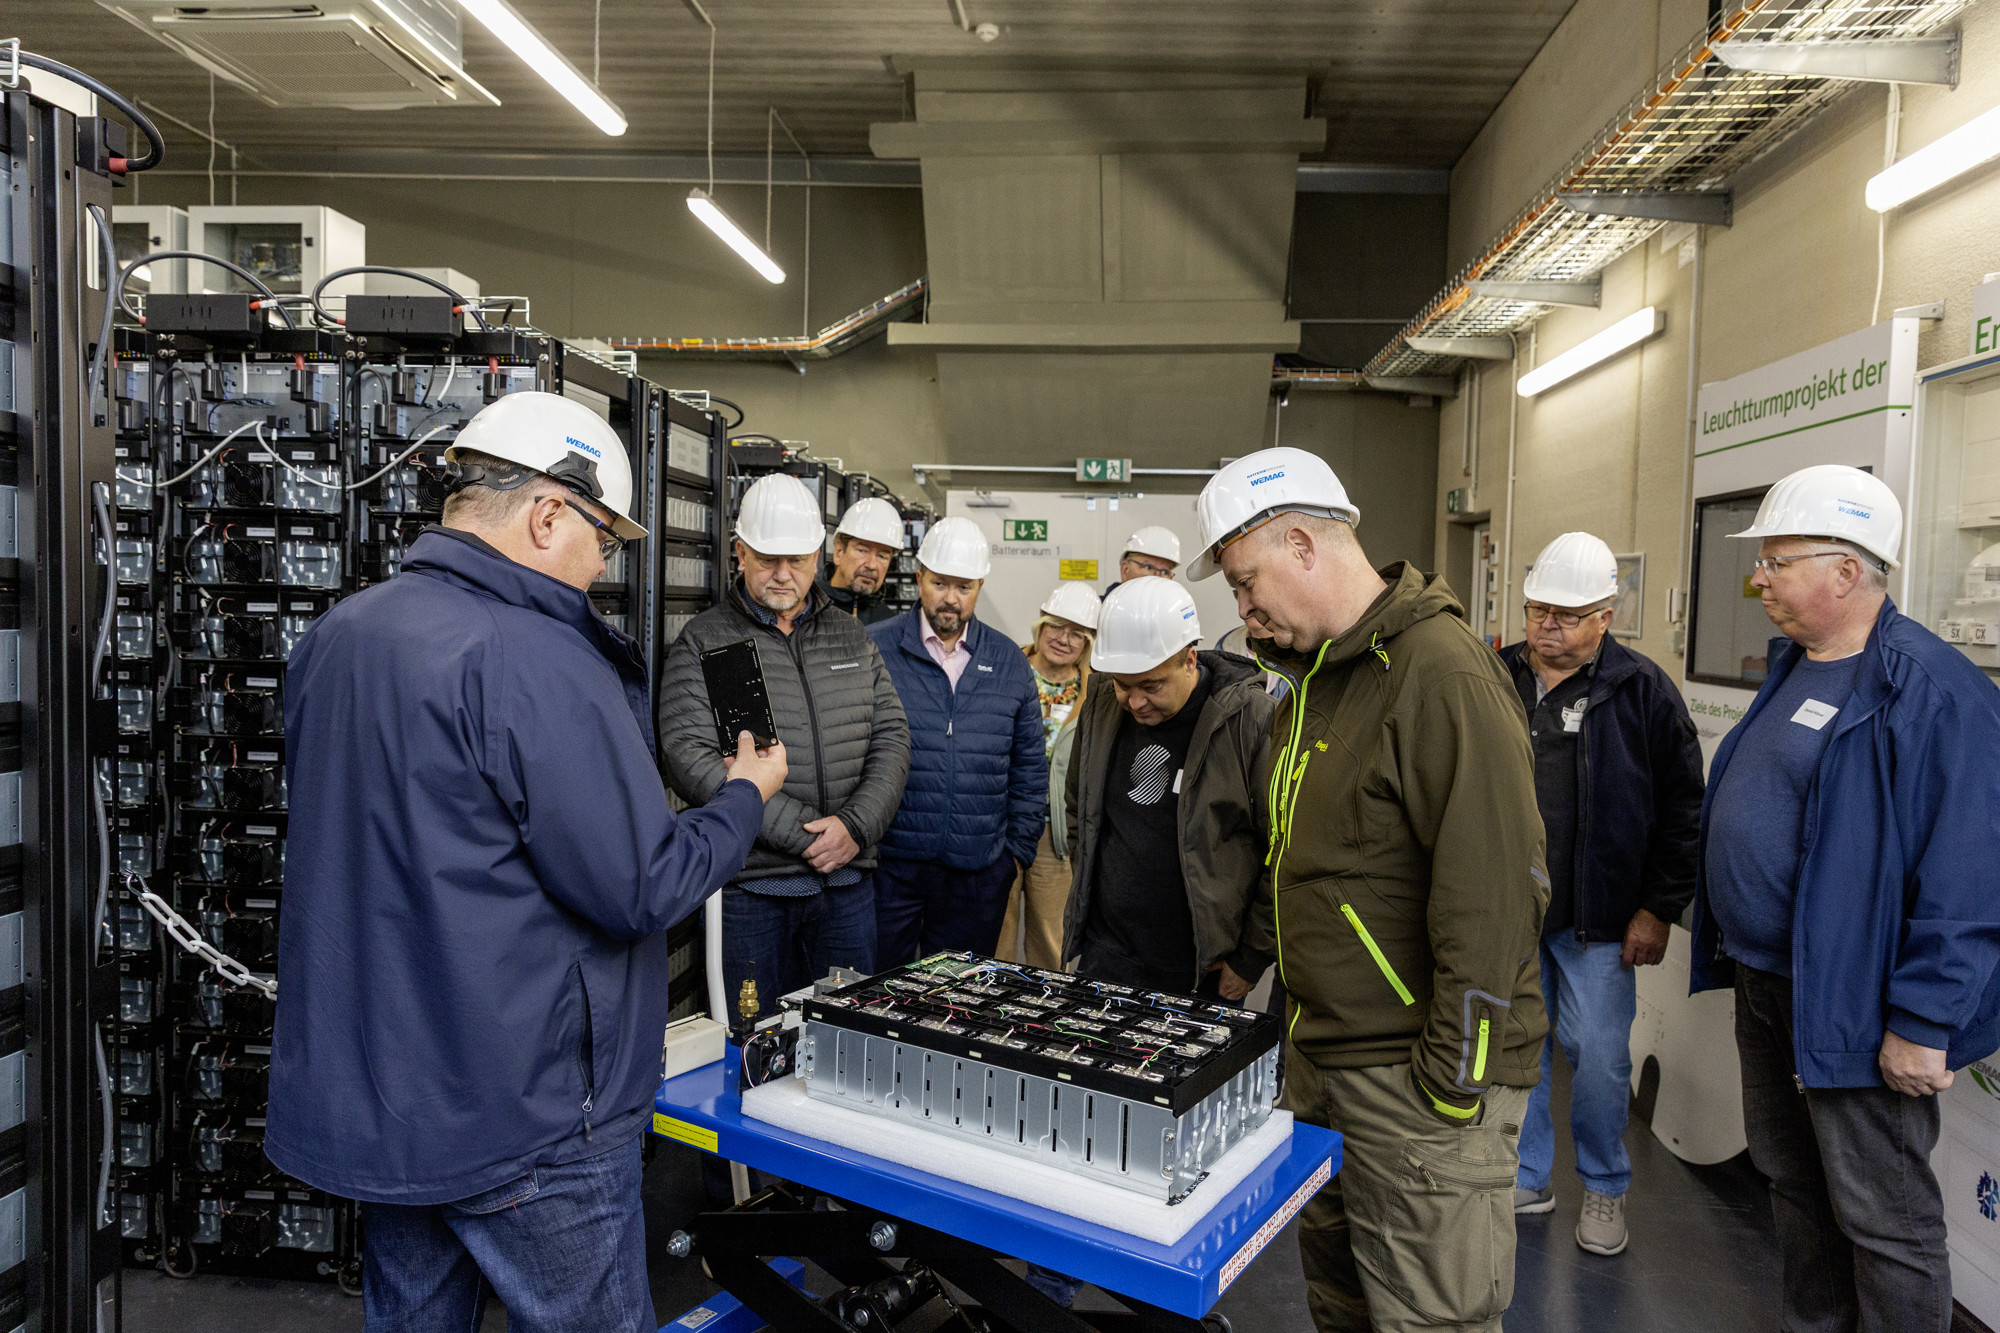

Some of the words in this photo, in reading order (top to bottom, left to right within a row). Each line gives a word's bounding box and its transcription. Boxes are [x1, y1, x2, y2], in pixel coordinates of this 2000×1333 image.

[1703, 368, 1847, 435] Leuchtturmprojekt
[1852, 358, 1887, 391] der
[566, 435, 601, 458] WEMAG
[1250, 471, 1285, 487] WEMAG
[1838, 505, 1871, 519] WEMAG
[991, 544, 1051, 556] Batterieraum
[1056, 546, 1060, 555] 1
[1951, 628, 1961, 639] SX
[1975, 628, 1986, 640] CX
[1690, 698, 1707, 714] Ziele
[1709, 701, 1721, 717] des
[1256, 1227, 1265, 1242] DO
[1267, 1212, 1280, 1231] NOT
[1282, 1190, 1300, 1213] WORK
[1300, 1171, 1319, 1195] UNDER
[1320, 1158, 1331, 1176] LIFT
[1219, 1260, 1246, 1292] UNLESS
[1247, 1252, 1254, 1263] IT
[1255, 1243, 1262, 1255] IS
[1262, 1193, 1308, 1246] MECHANICALLY
[1308, 1170, 1330, 1200] LOCKED
